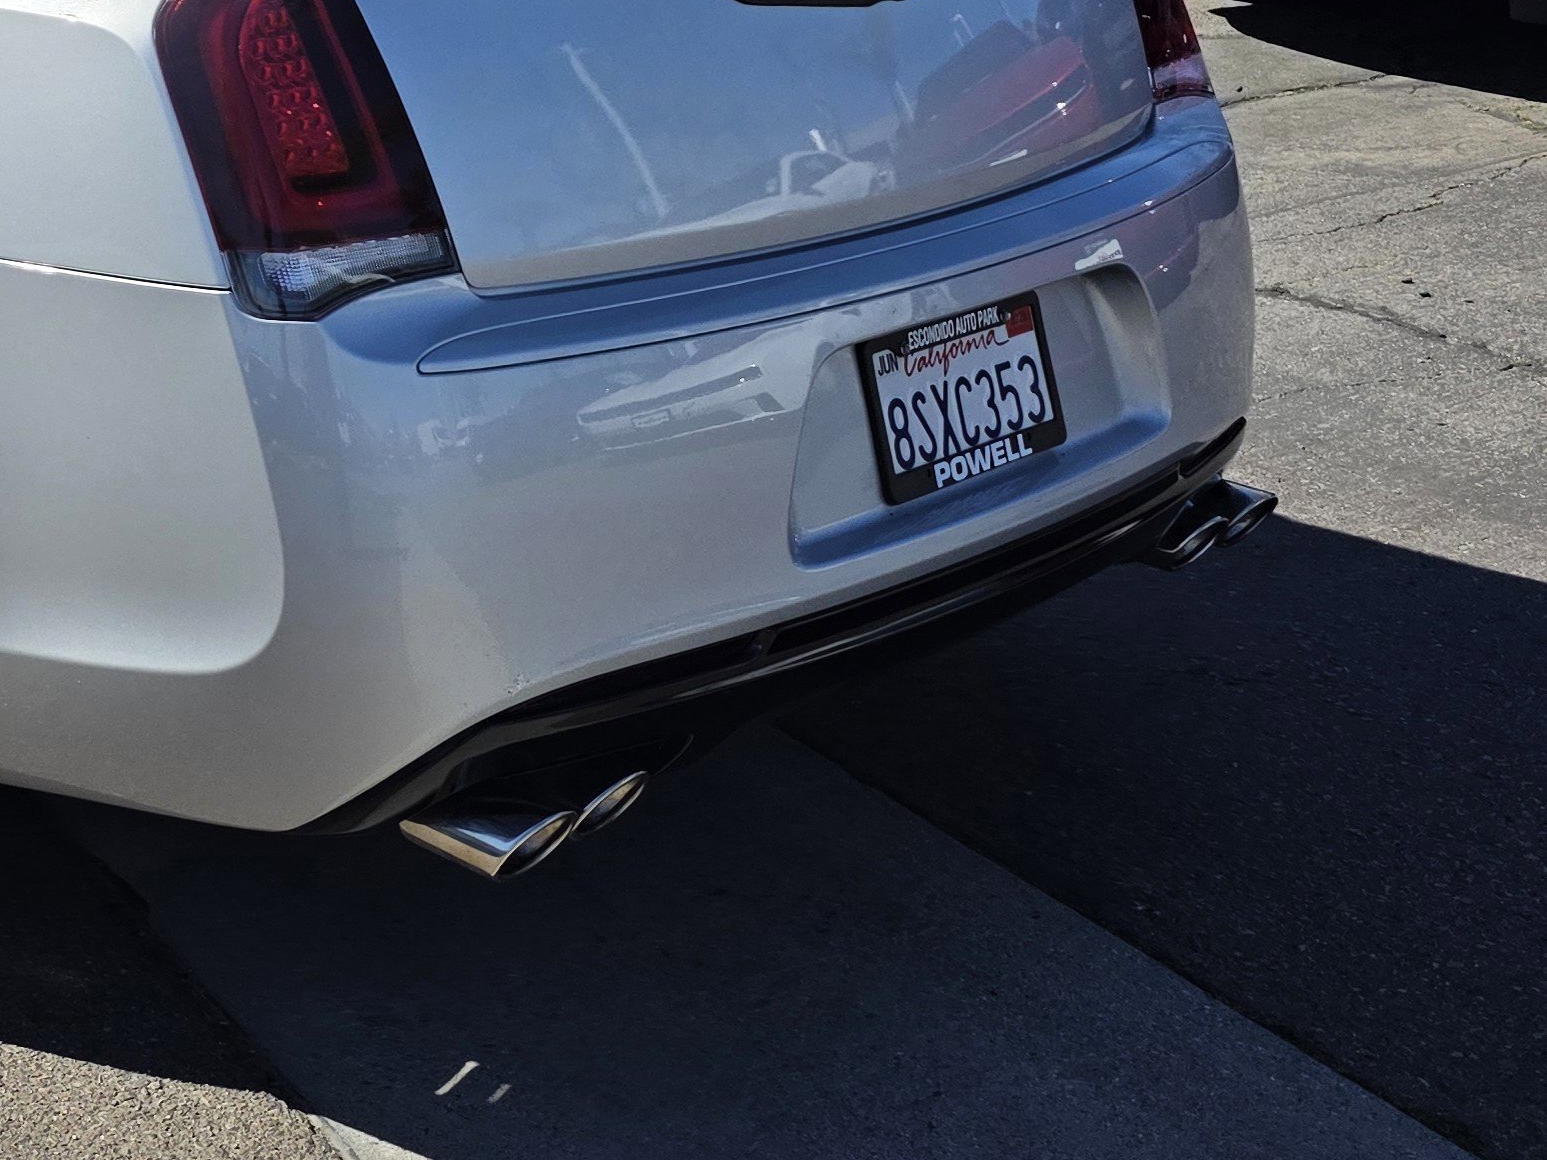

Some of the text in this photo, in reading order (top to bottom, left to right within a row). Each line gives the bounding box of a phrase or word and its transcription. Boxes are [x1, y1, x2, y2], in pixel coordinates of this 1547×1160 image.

[904, 328, 1009, 377] California
[908, 305, 1000, 351] ESCONDIDO AUTO PARK
[877, 353, 899, 377] JUN
[887, 354, 1046, 471] 8SXC353
[933, 433, 1033, 489] POWELL
